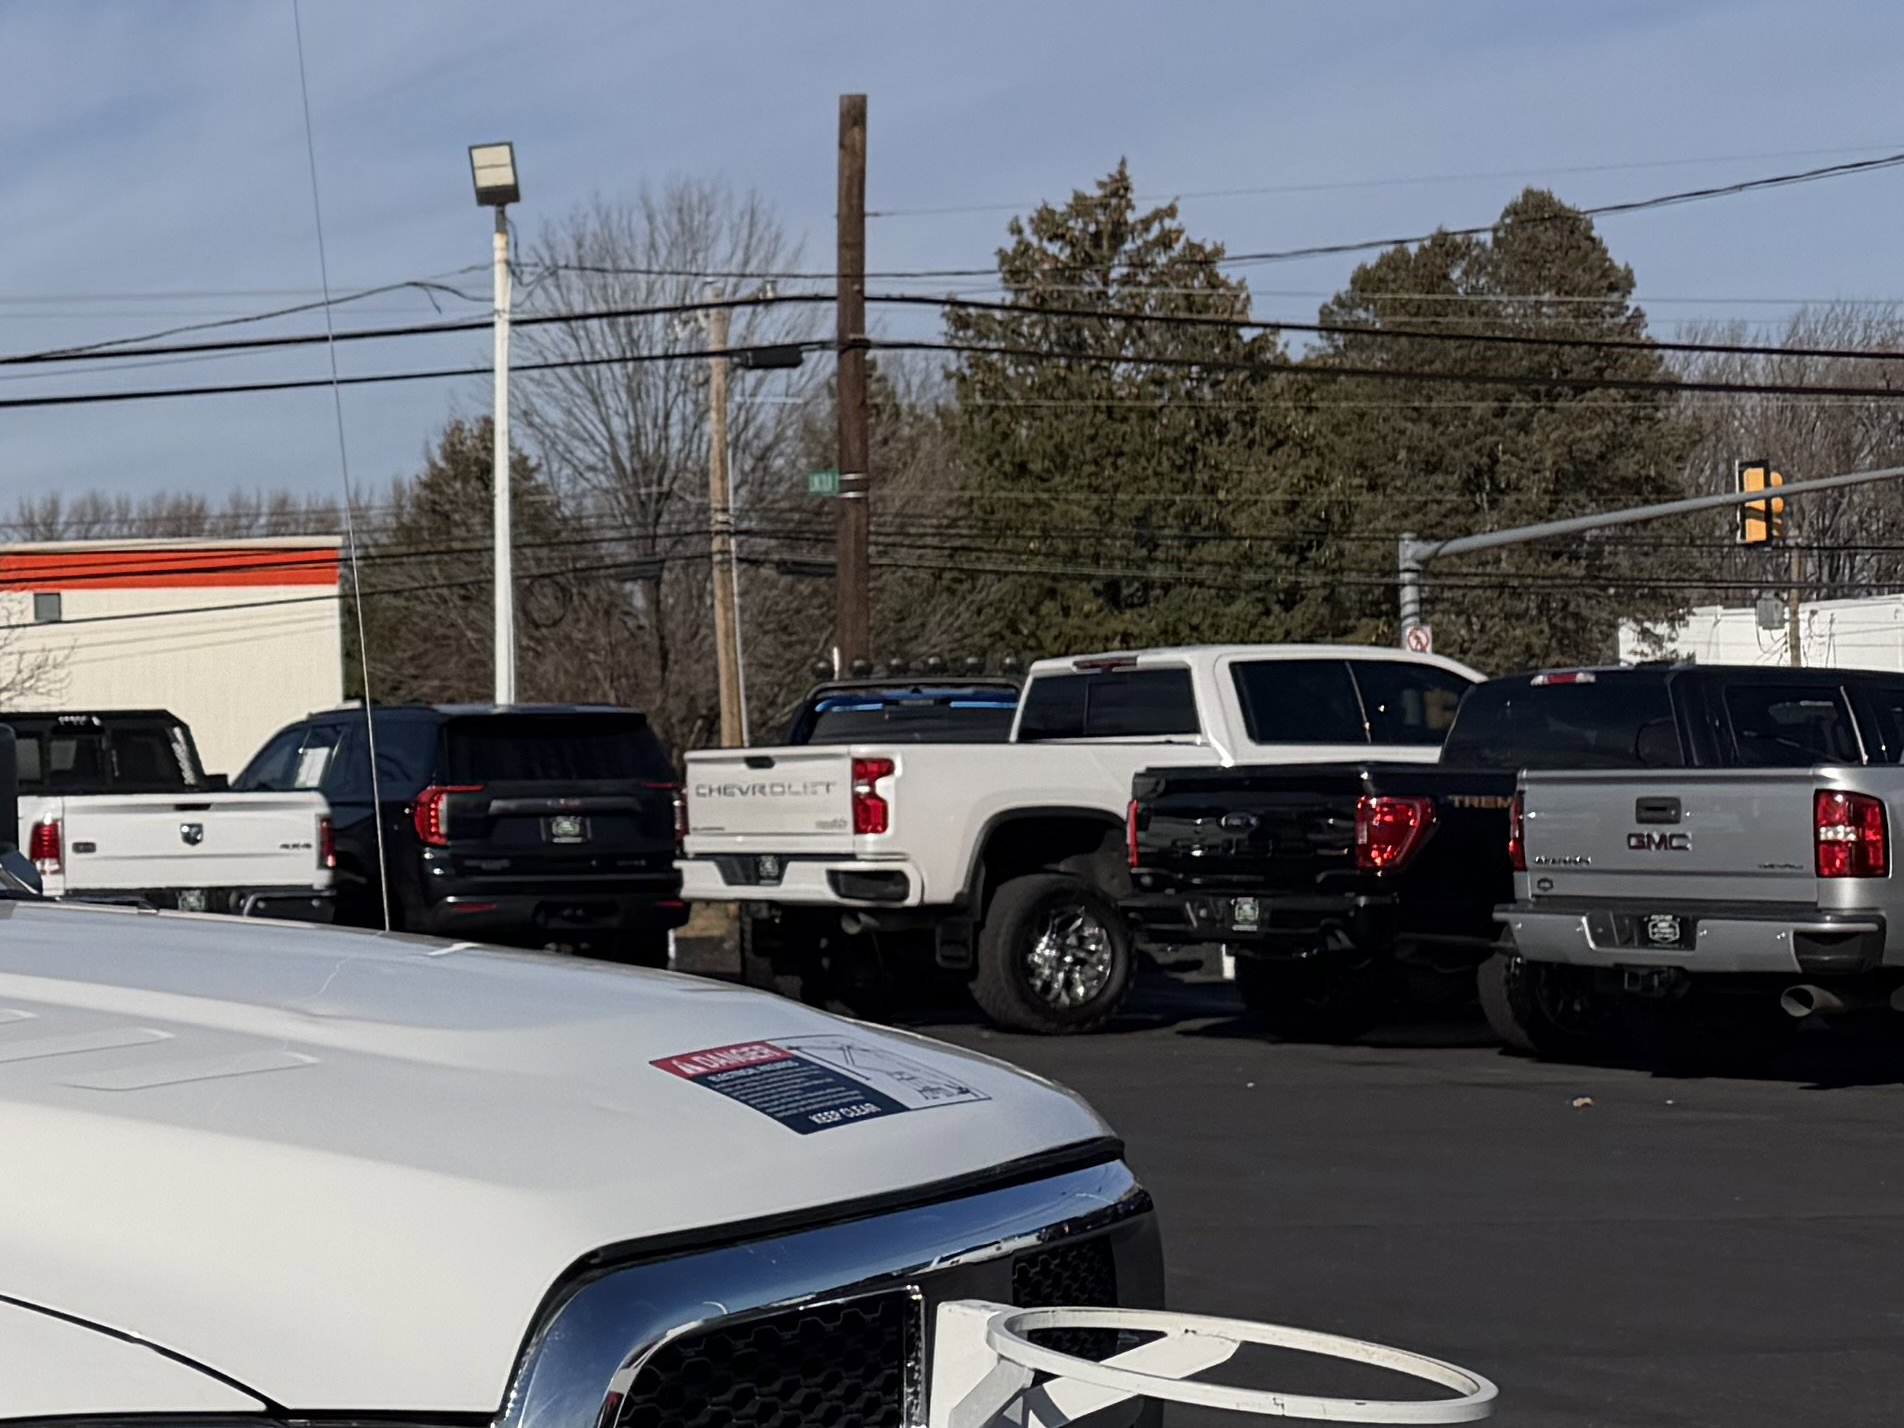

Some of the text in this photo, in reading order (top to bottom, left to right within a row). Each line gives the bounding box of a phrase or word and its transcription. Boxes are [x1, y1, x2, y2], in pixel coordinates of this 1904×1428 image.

[1626, 831, 1693, 852] GMC
[697, 1043, 782, 1070] DANGER
[808, 1102, 882, 1125] KEEP CLEAR
